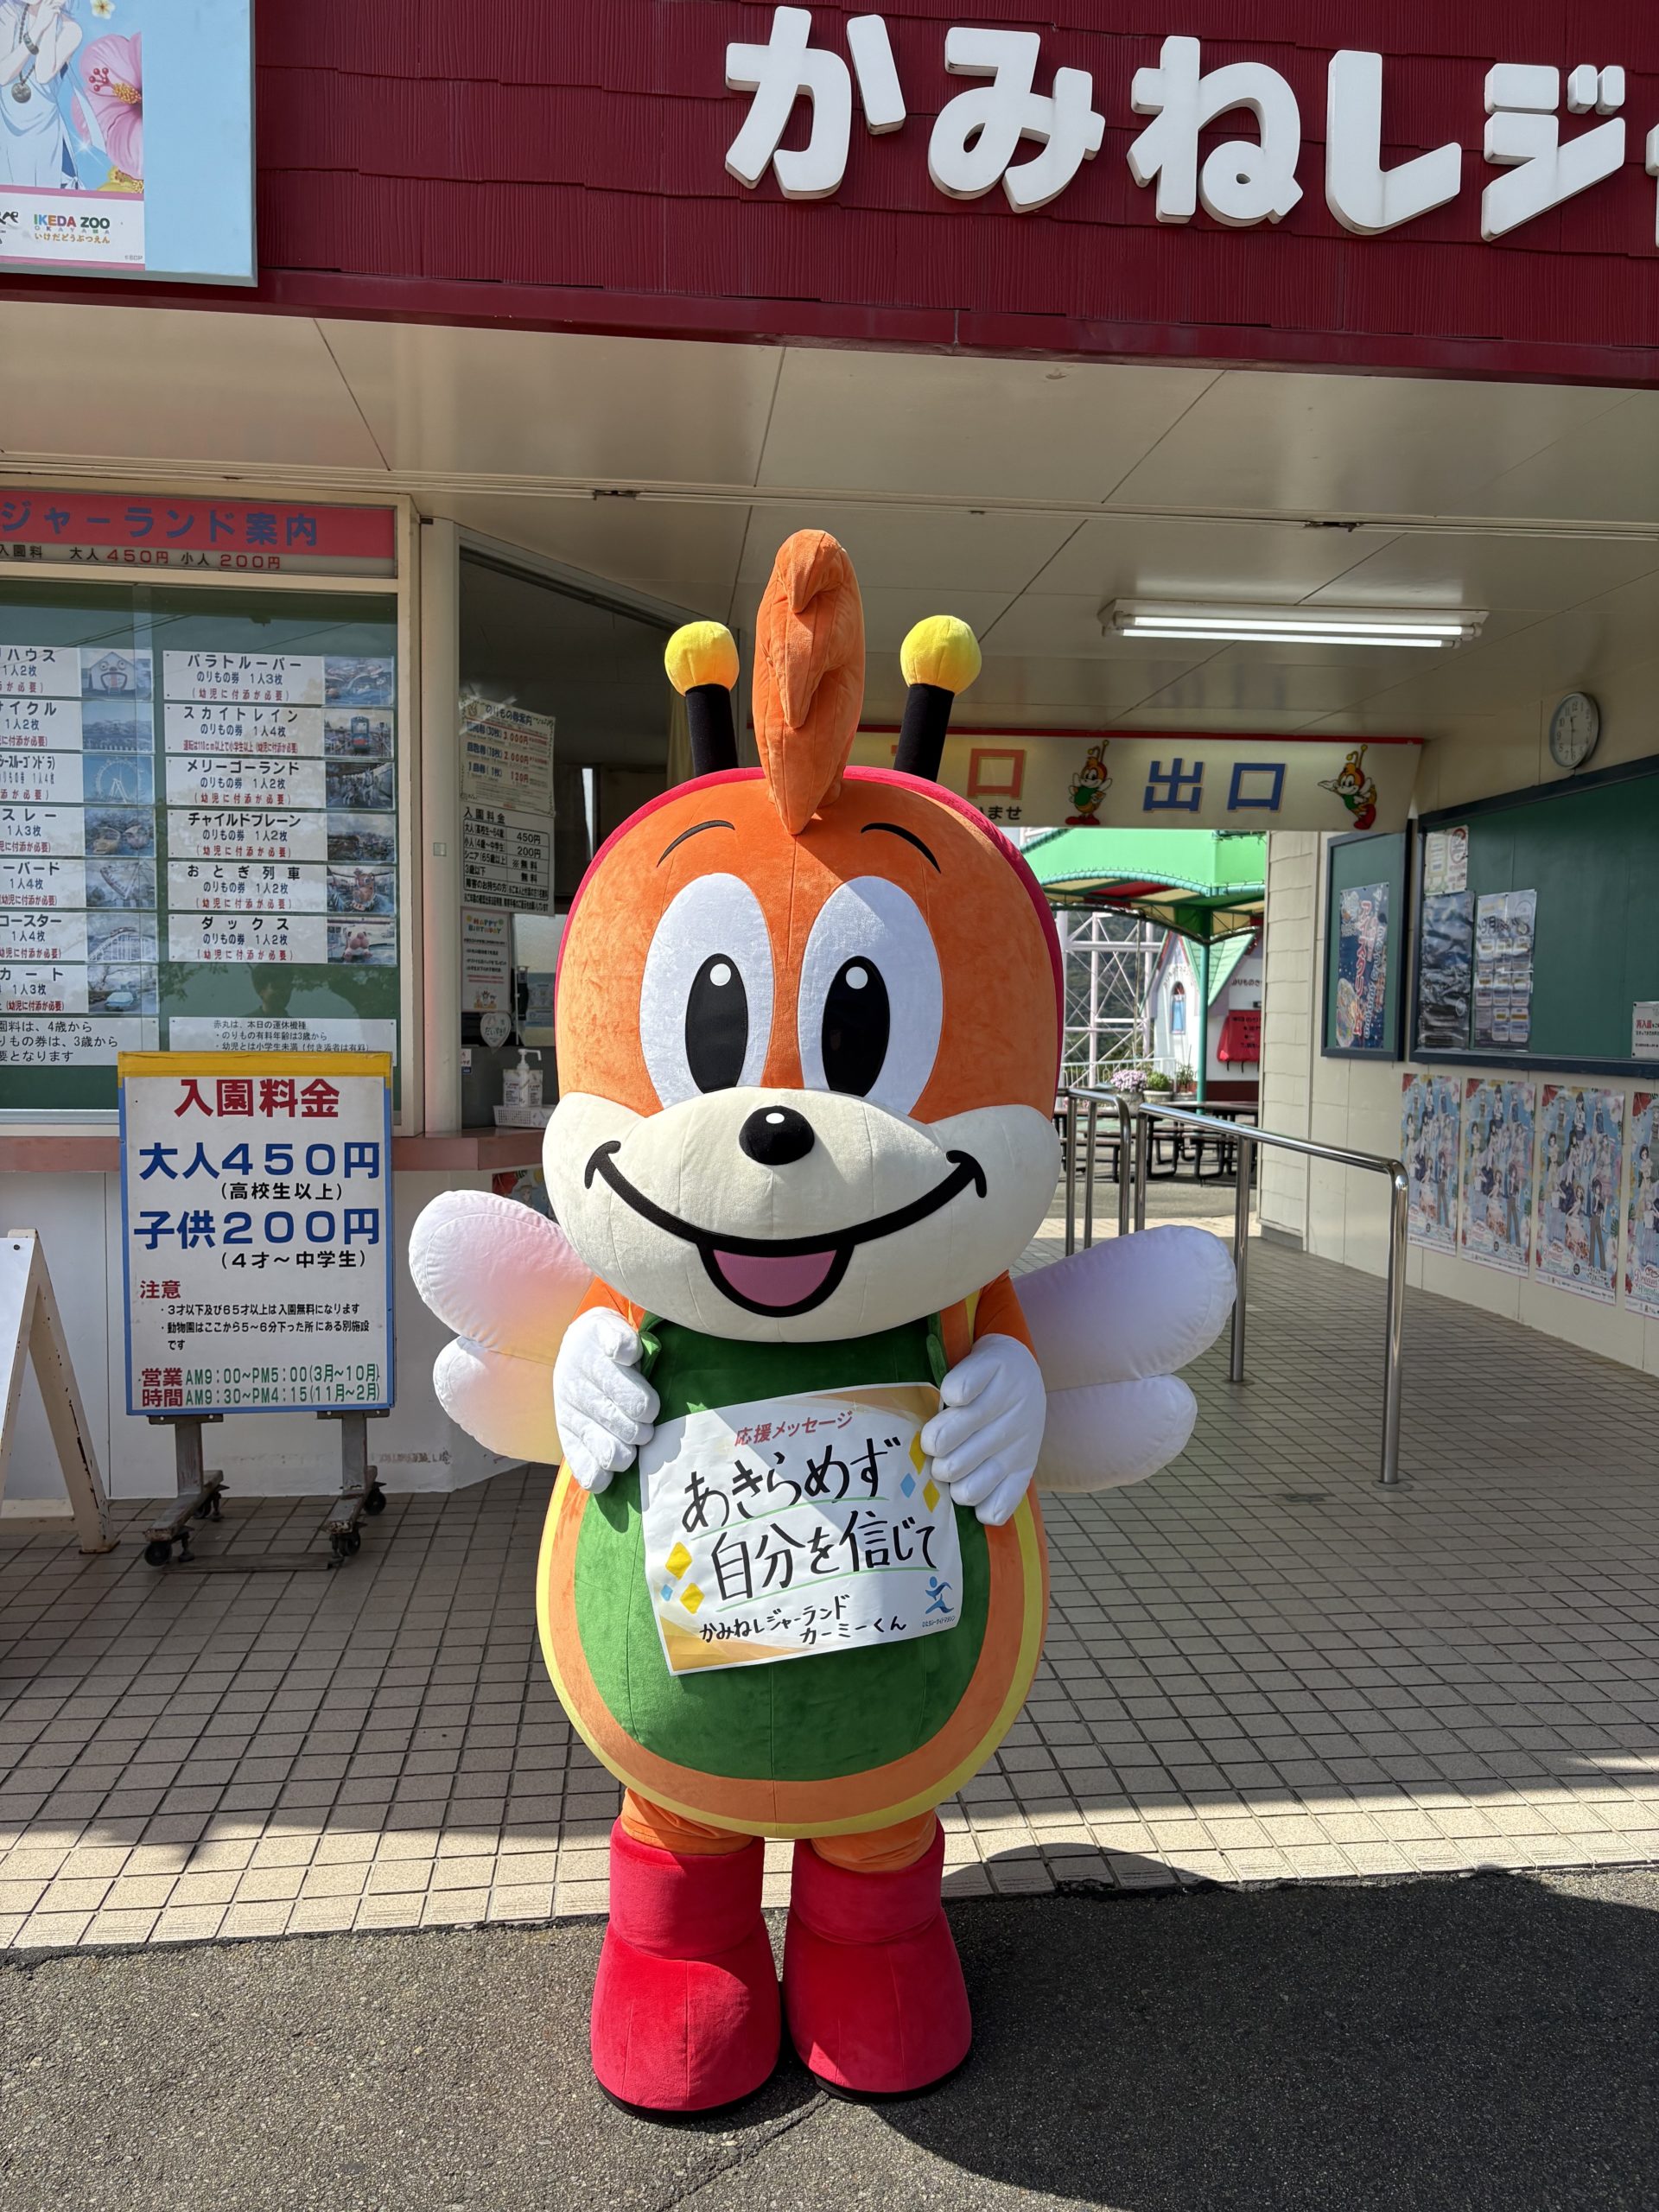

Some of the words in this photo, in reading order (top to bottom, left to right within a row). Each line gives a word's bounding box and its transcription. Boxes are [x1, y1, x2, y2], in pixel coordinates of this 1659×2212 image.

[724, 5, 1659, 243] かみねレジ
[34, 213, 76, 228] IKEDA
[80, 216, 111, 229] ZOO
[34, 232, 111, 245] いけだどうぶつえん
[1, 500, 317, 547] ジャーランド案内
[69, 547, 99, 562] 大人
[105, 549, 169, 565] 450円
[181, 550, 211, 566] 小人
[219, 553, 281, 570] 200円
[196, 671, 239, 684] のりもの券
[183, 706, 298, 723] スカイトレイン
[200, 723, 243, 736] のりもの券
[187, 759, 300, 776] メリーゴーランド
[200, 777, 243, 789] のりもの券
[1142, 757, 1287, 814] 出口
[464, 807, 505, 824] 入園料金
[202, 830, 245, 842] のりもの券
[516, 832, 541, 845] 450円
[517, 846, 542, 859] 200円
[187, 865, 301, 880] おとぎ列車
[520, 872, 537, 884] 無料
[203, 880, 245, 893] のりもの券
[201, 916, 289, 931] ダックス
[473, 917, 499, 927] HAPPY
[202, 933, 245, 945] のりもの券
[174, 1078, 340, 1118] 入園料金
[138, 1141, 380, 1181] 大人450円
[220, 1182, 343, 1201] (高校生以上)
[133, 1208, 380, 1250] 子供200円
[139, 1280, 181, 1300] 注意
[168, 1340, 186, 1351] です
[142, 1367, 183, 1387] 営業
[142, 1388, 183, 1408] 時間
[733, 1410, 855, 1447] 応援メッセージ
[681, 1436, 901, 1534] あきらめず
[710, 1510, 938, 1601] 自分を信じて
[698, 1593, 851, 1644] かみねレジャーランド
[799, 1616, 907, 1645] カーミーくん
